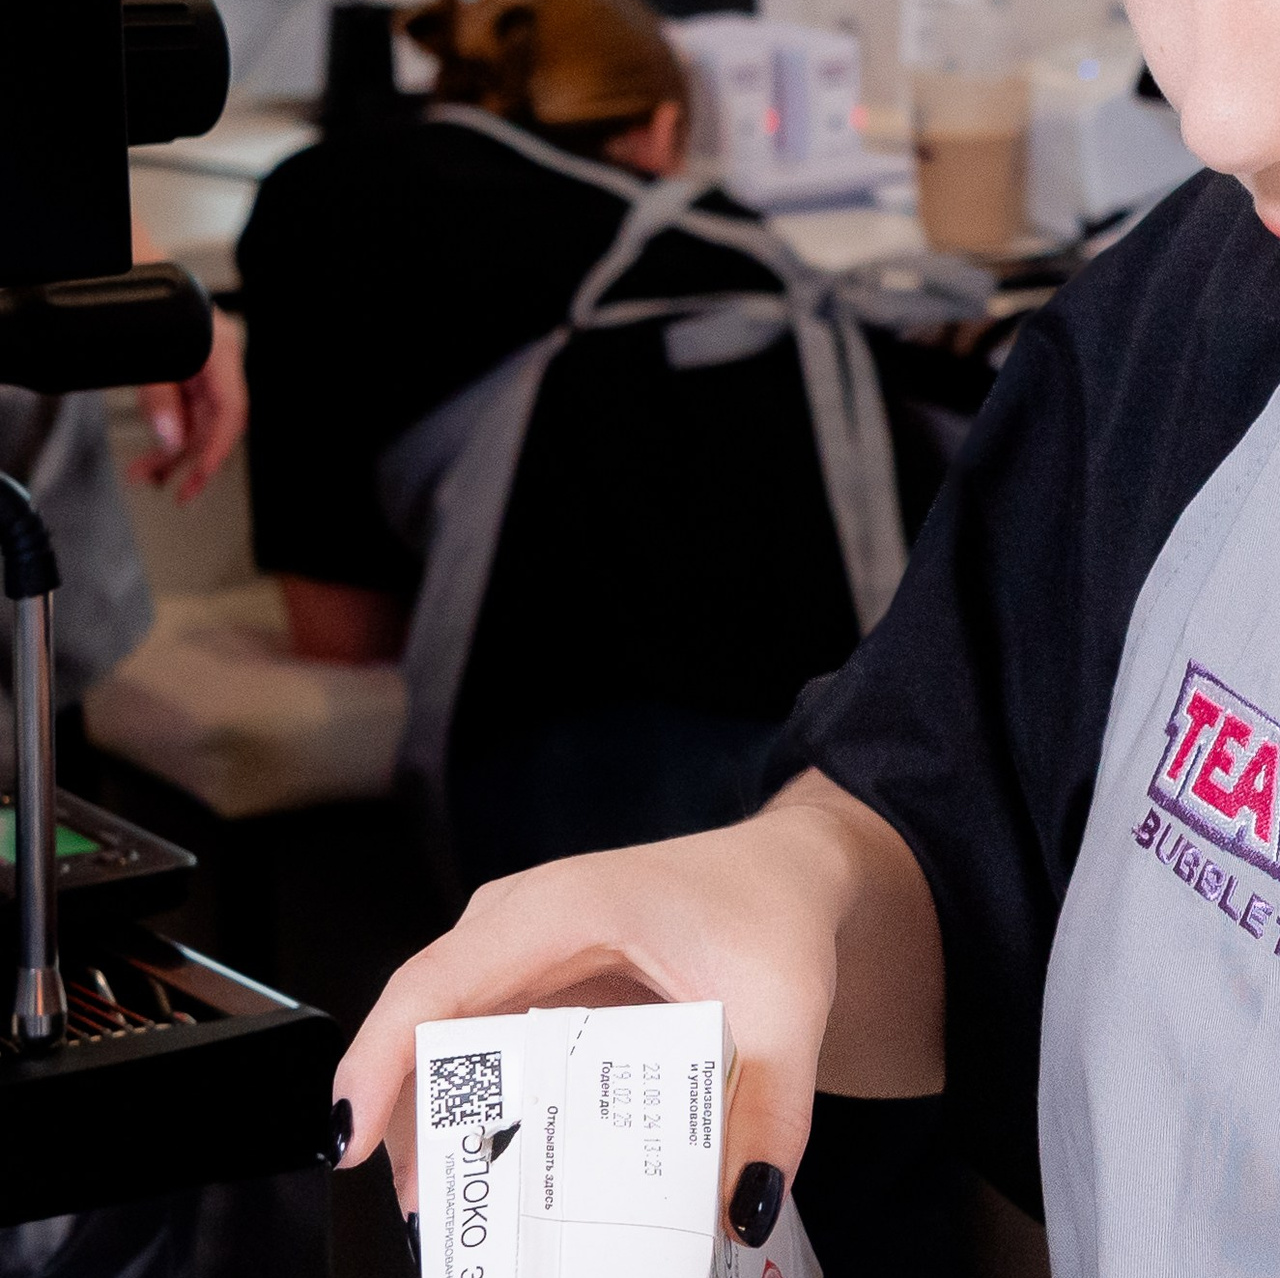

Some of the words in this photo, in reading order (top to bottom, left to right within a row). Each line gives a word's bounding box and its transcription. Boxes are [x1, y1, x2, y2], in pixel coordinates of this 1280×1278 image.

[1131, 807, 1275, 940] BUBBLE
[600, 1060, 612, 1098] Годен
[600, 1098, 609, 1121] до:
[612, 1063, 633, 1129] 19.02.25
[688, 1073, 698, 1147] упаковано:
[702, 1060, 716, 1150] Произведено
[545, 1105, 559, 1172] Открывать
[644, 1137, 662, 1178] 13:25
[544, 1172, 555, 1211] здесь
